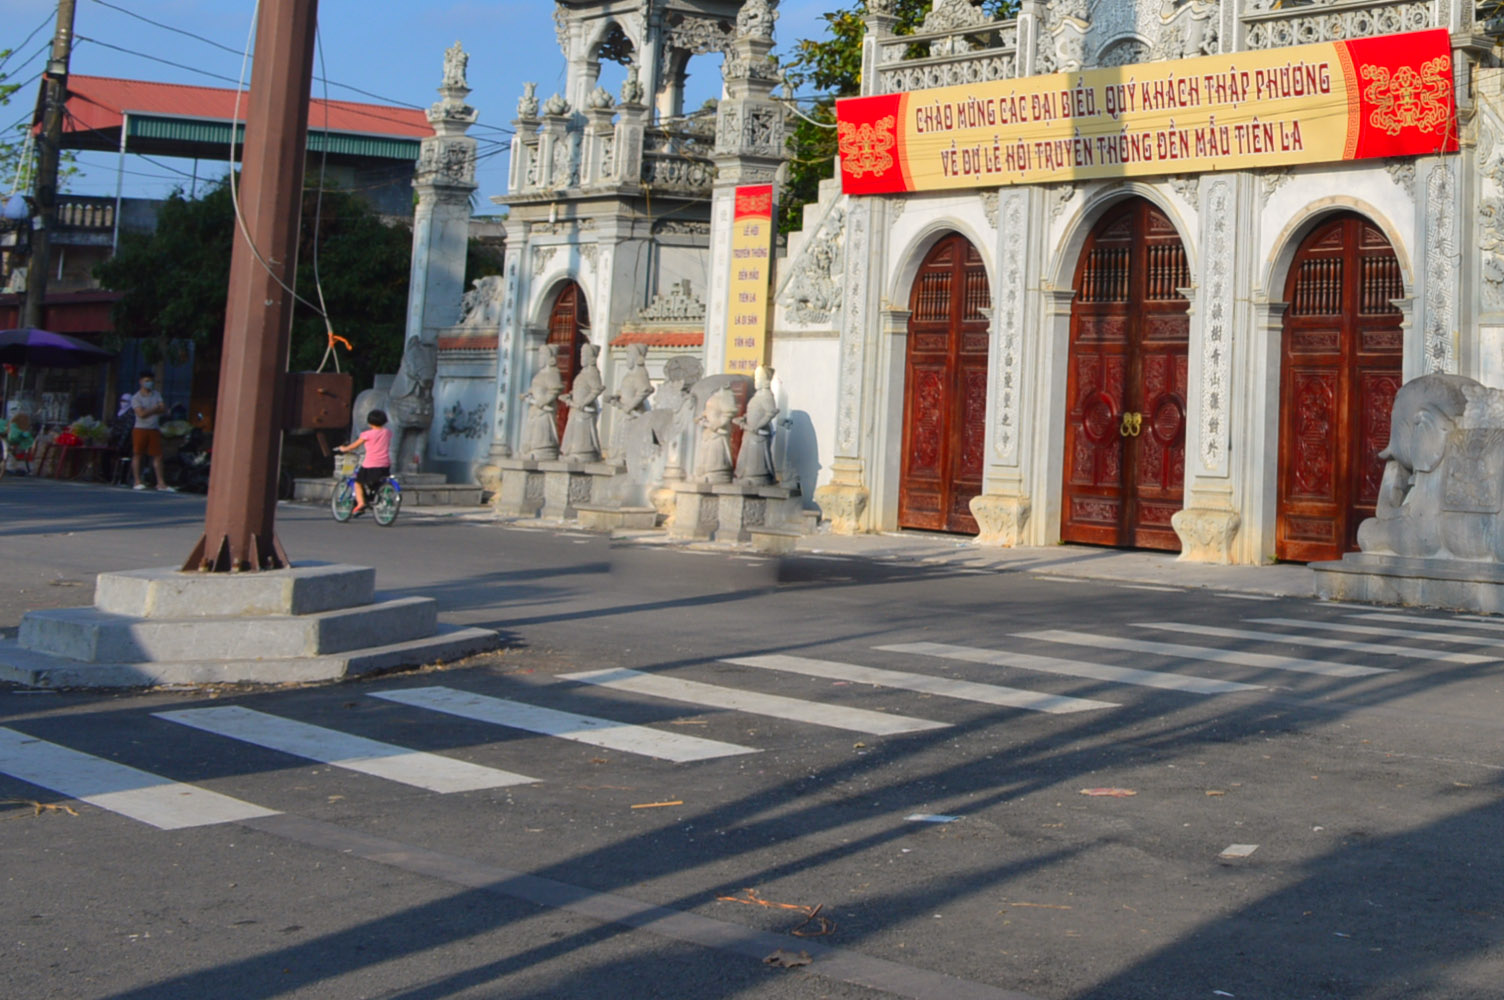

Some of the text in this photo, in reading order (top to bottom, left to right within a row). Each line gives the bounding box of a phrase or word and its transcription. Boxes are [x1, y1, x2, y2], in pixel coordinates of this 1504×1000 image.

[916, 99, 953, 133] CHÀO
[957, 96, 996, 129] MỪNG
[1000, 90, 1027, 125] CÁC
[1032, 92, 1057, 127] ĐẠI
[1105, 77, 1136, 120] QUÝ
[1141, 72, 1200, 111] KHÁCH
[1204, 66, 1250, 109] THẬP
[1255, 61, 1331, 101] PHƯƠNG
[941, 116, 1303, 180] VỀ DỰ LỄ HỘI TRUYỀN THỐNG ĐỀN MẪU TIÊN LA
